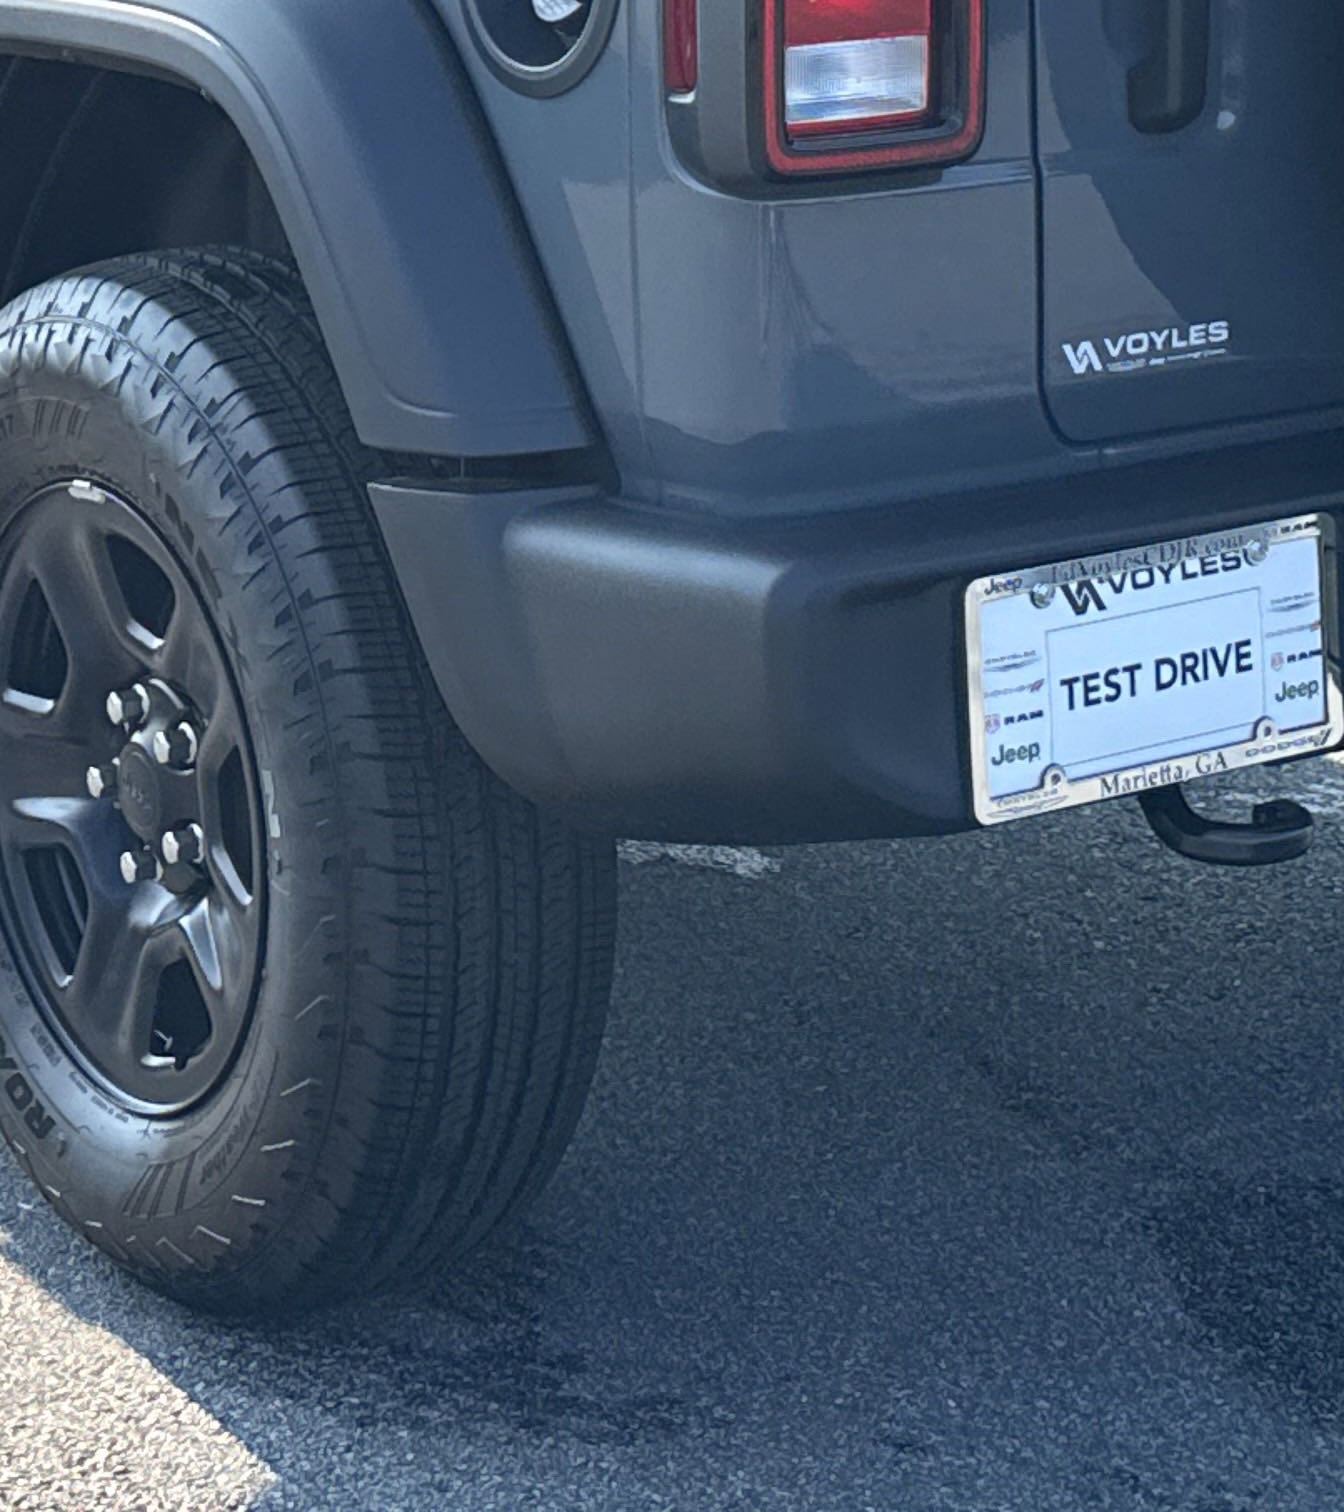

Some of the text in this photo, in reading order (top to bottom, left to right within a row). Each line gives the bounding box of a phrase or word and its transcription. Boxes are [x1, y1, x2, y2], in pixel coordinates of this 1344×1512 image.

[1104, 320, 1230, 358] VOYLES
[984, 575, 1024, 596] Jeep
[1104, 547, 1243, 595] VOYLES
[1060, 638, 1254, 711] TEST DRIVE
[1275, 678, 1320, 703] Jeep
[1003, 709, 1045, 726] RAM
[991, 741, 1041, 767] Jeep
[1099, 750, 1229, 798] Marietta, GA
